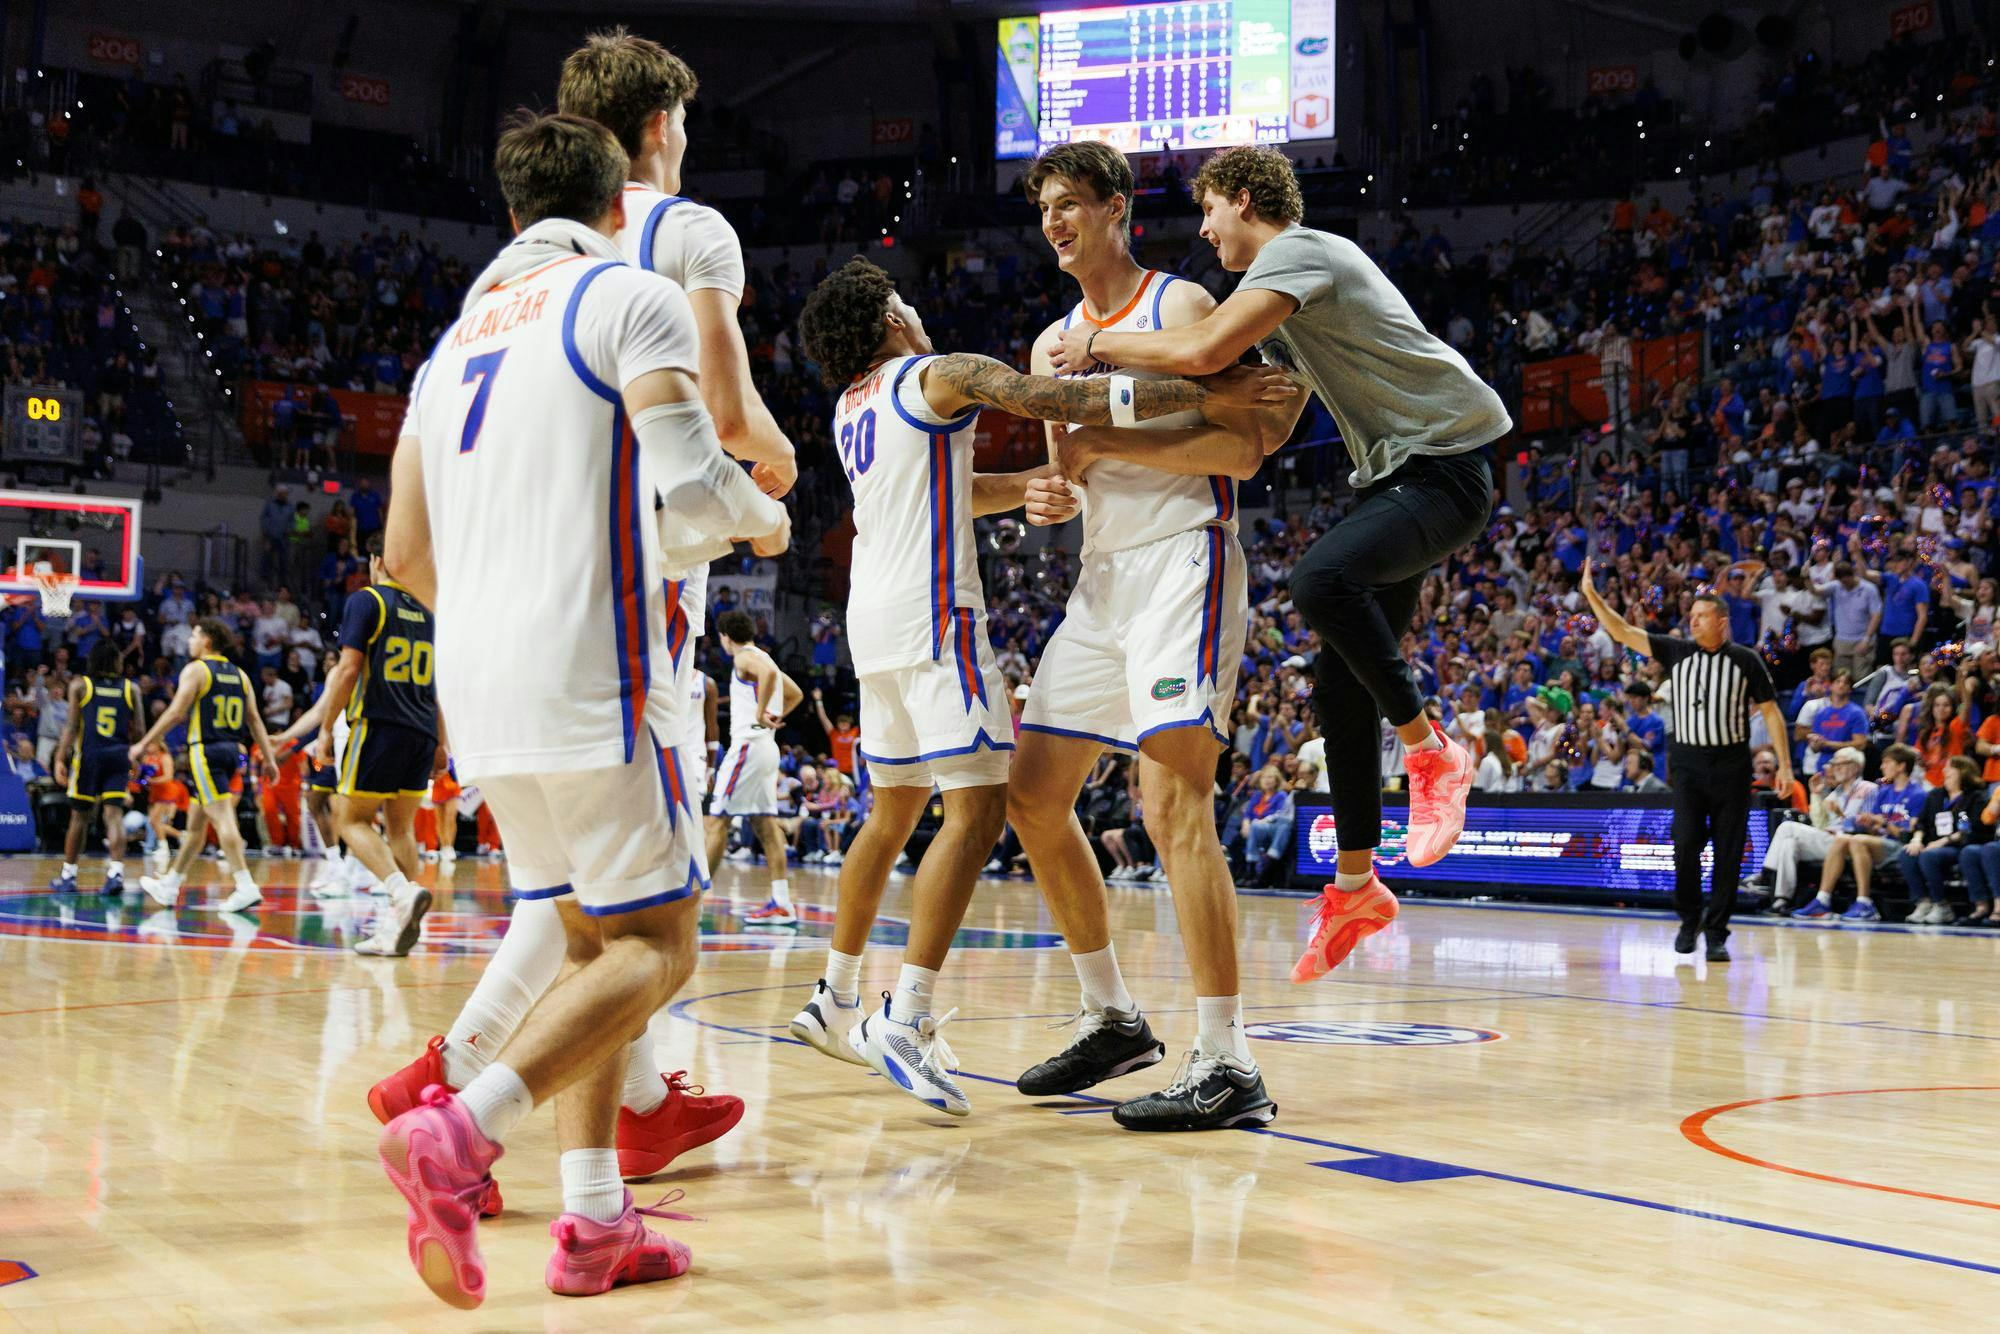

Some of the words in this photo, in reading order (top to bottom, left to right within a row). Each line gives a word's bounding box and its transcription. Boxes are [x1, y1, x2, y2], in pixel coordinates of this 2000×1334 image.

[91, 40, 139, 63] 206
[344, 80, 387, 103] 206
[1590, 71, 1633, 91] 209
[876, 123, 909, 141] 207
[450, 288, 549, 350] KLAVŽAR
[459, 345, 511, 455] 7
[845, 373, 886, 415] BROWN
[840, 407, 877, 483] 20
[383, 635, 434, 686] 20
[96, 706, 117, 738] 5
[212, 694, 243, 730] 10
